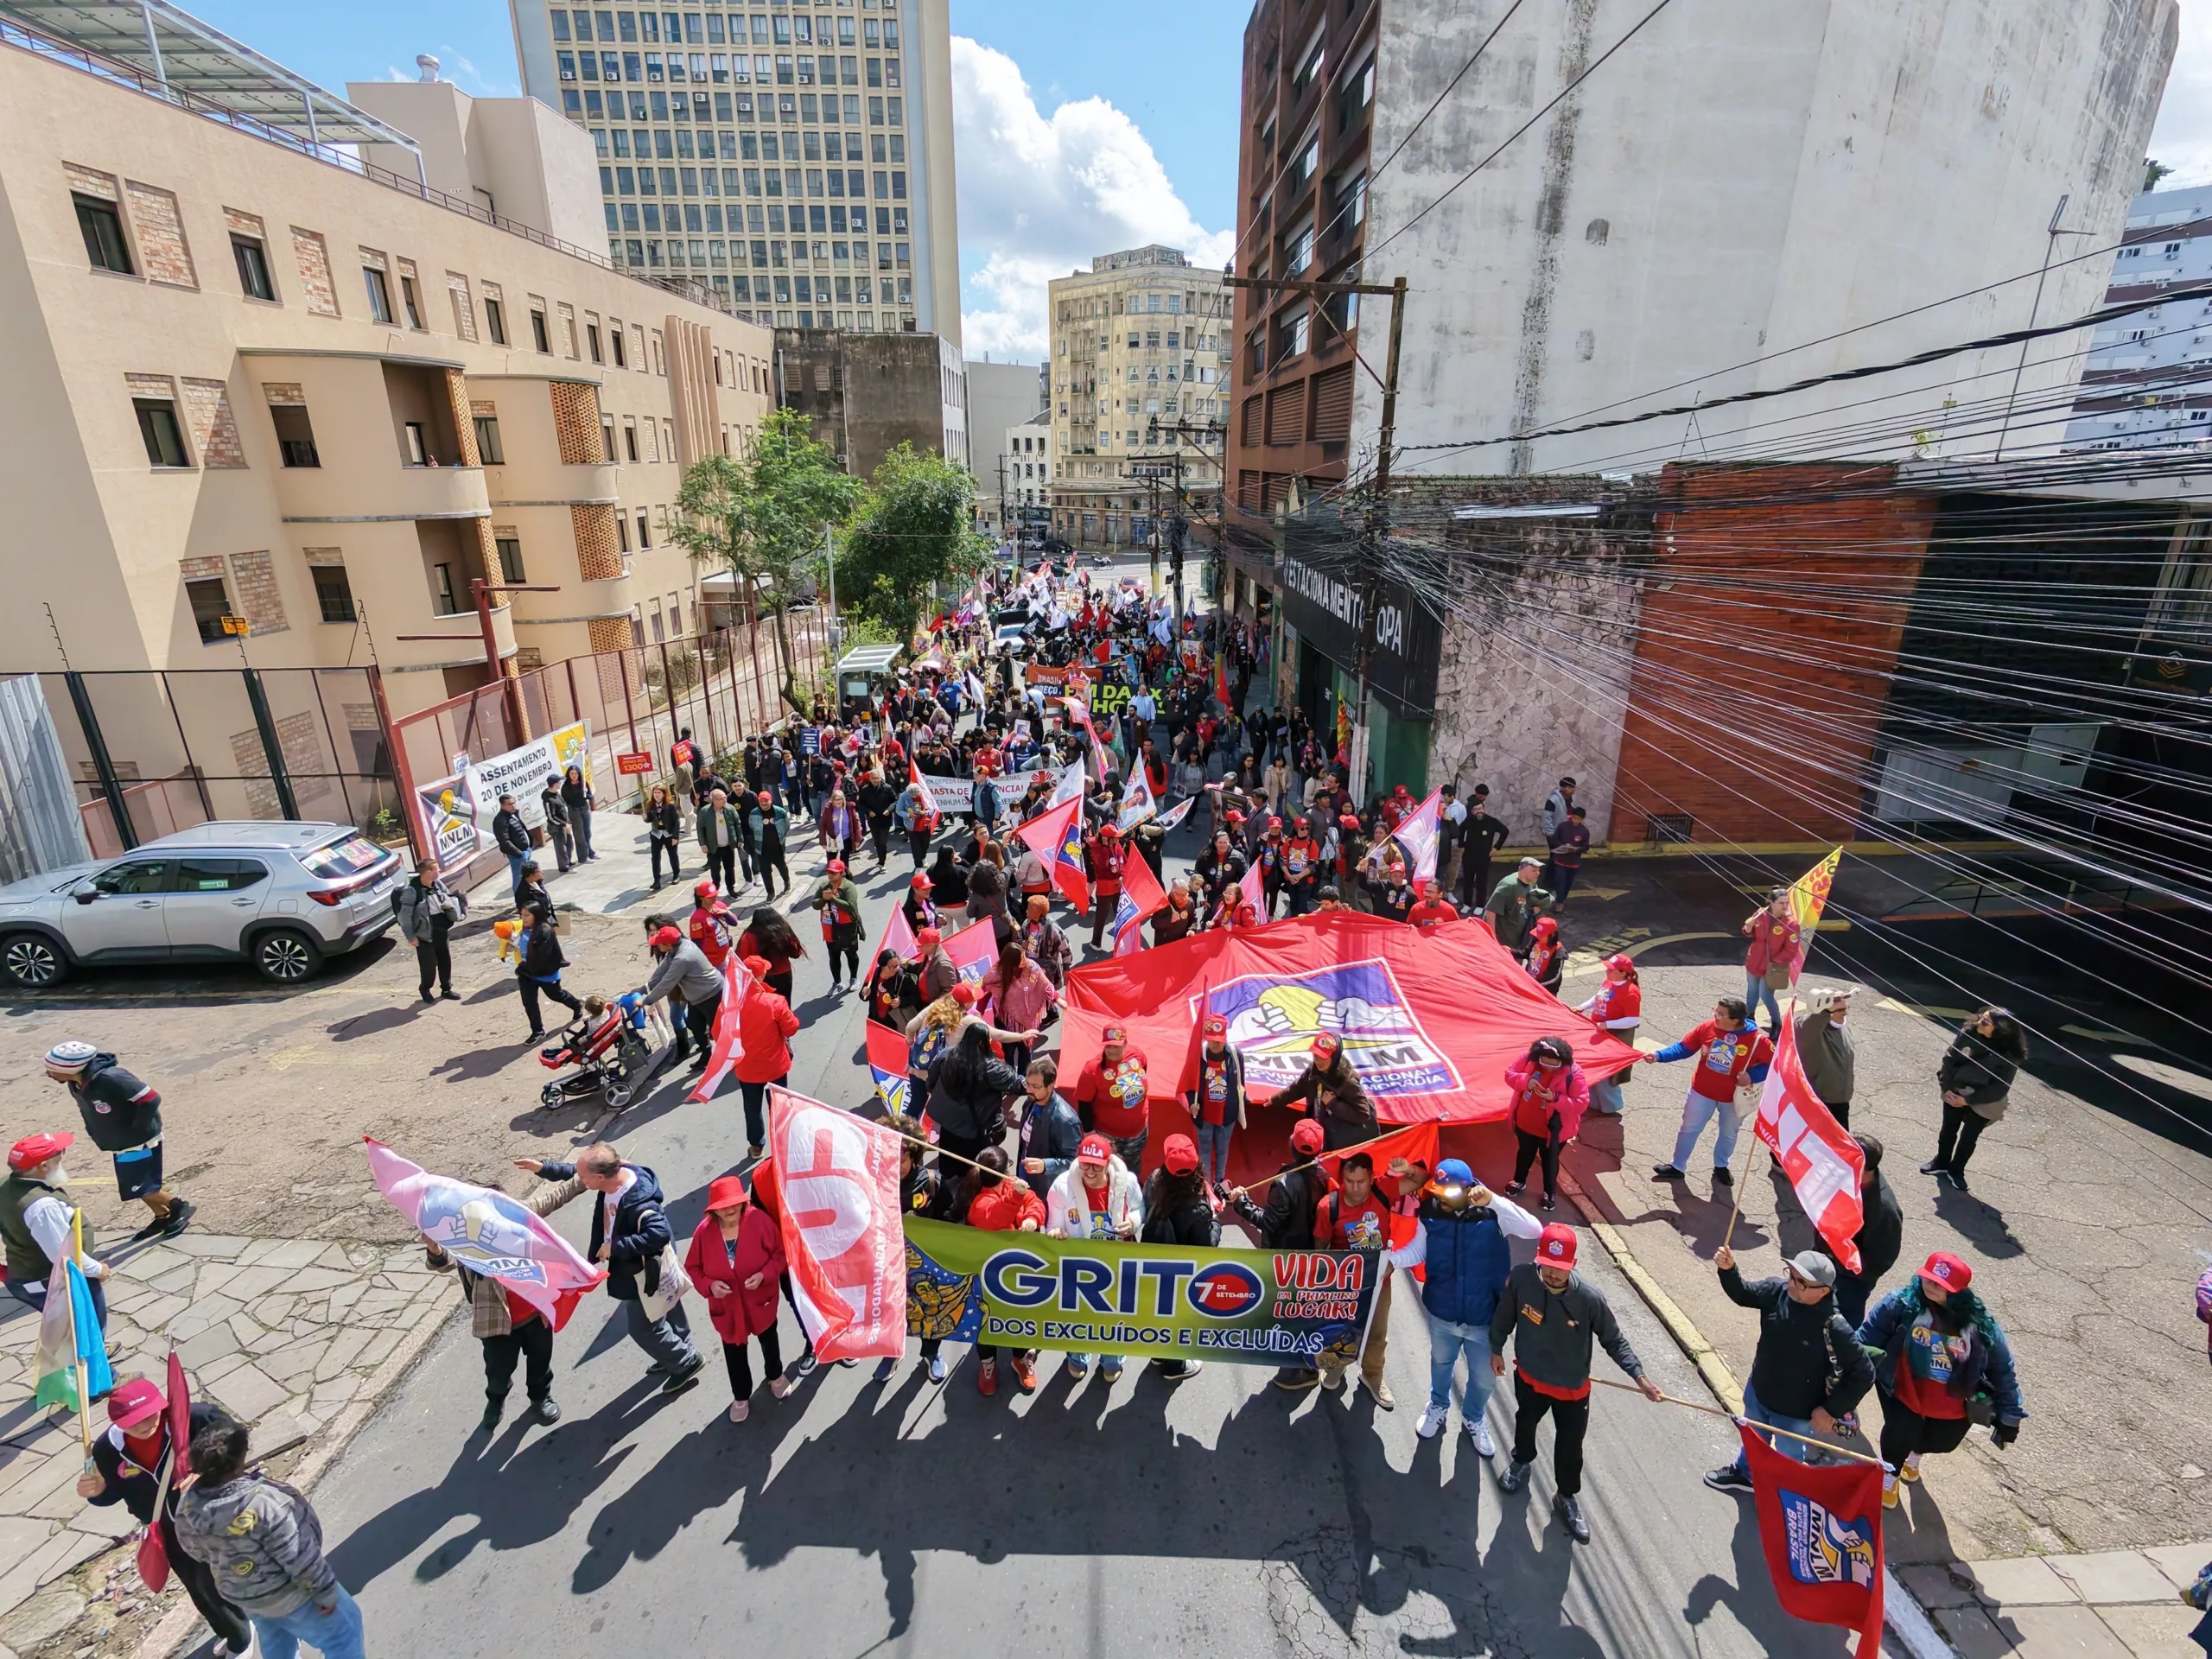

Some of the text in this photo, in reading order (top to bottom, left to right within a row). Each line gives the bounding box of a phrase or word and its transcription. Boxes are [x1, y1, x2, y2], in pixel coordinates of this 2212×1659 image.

[1376, 605, 1402, 657] OPA
[1103, 681, 1132, 700] DA
[480, 747, 547, 784] ASSENTAMENTO
[624, 762, 643, 772] 1300
[481, 760, 553, 803] 20 DE NOVEMBRO
[439, 823, 474, 852] MNLM
[1710, 1055, 1730, 1065] MNLM
[1125, 1088, 1144, 1101] MNLM
[1082, 1145, 1103, 1159] LULA
[981, 1247, 1265, 1319] GRITO
[1273, 1253, 1364, 1292] VIDA
[1194, 1281, 1214, 1304] 7
[1296, 1290, 1360, 1302] PRIMEIRO
[1273, 1301, 1357, 1319] LUGAR!
[988, 1316, 1325, 1355] DOS EXCLUÍDOS E EXCLUÍDAS
[1786, 1507, 1799, 1560] BRASIL
[1811, 1509, 1834, 1580] MNLM
